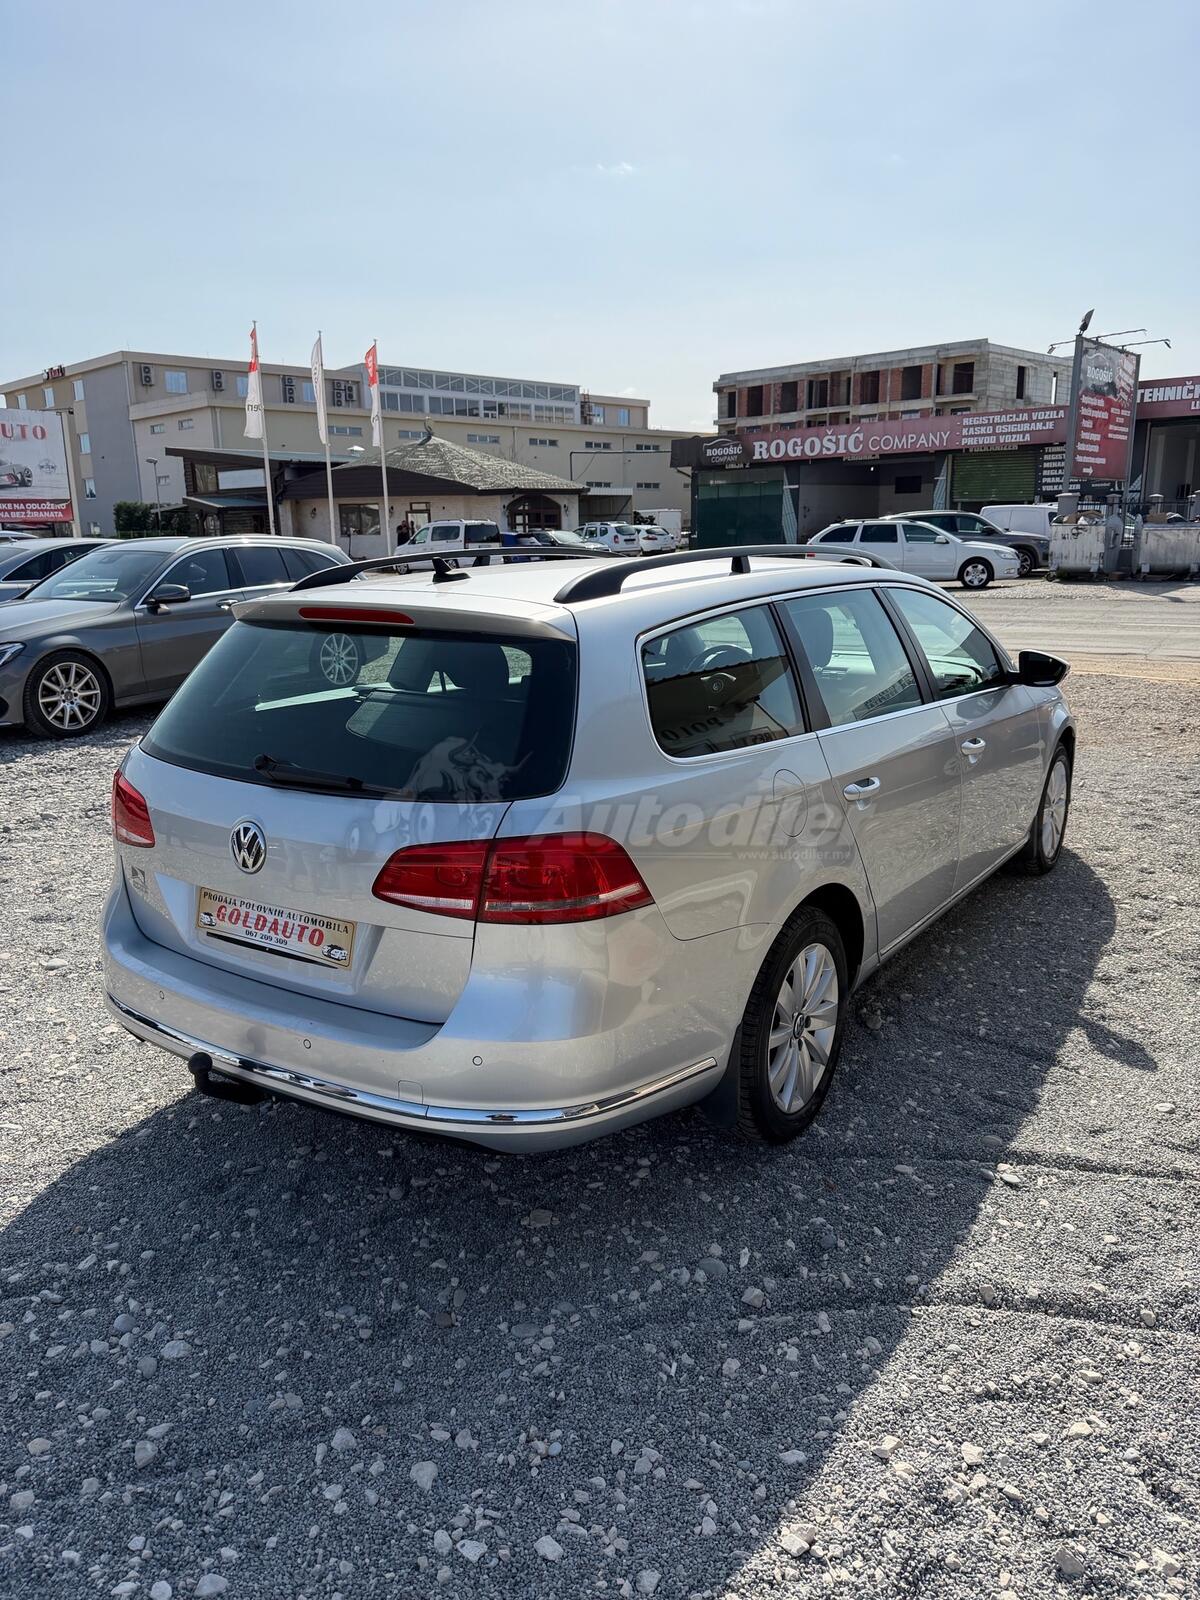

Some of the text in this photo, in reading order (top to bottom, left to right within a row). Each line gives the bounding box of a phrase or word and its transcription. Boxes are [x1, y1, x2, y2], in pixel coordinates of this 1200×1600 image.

[963, 410, 1065, 426] REGISTRACIJA VOZILA
[962, 421, 1055, 436] KASKO OSIGURANJE
[752, 426, 950, 460] ROGOŠIĆ COMPANY
[961, 433, 1031, 446] PREVOD VOZILA
[706, 444, 743, 456] ROGOŠIĆ
[711, 455, 738, 463] COMPANY
[203, 891, 349, 934] PRODAJA POLOVNIH AUTOMOBILA
[216, 905, 325, 947] GOLDAUTO
[245, 929, 288, 946] 067 209 309
